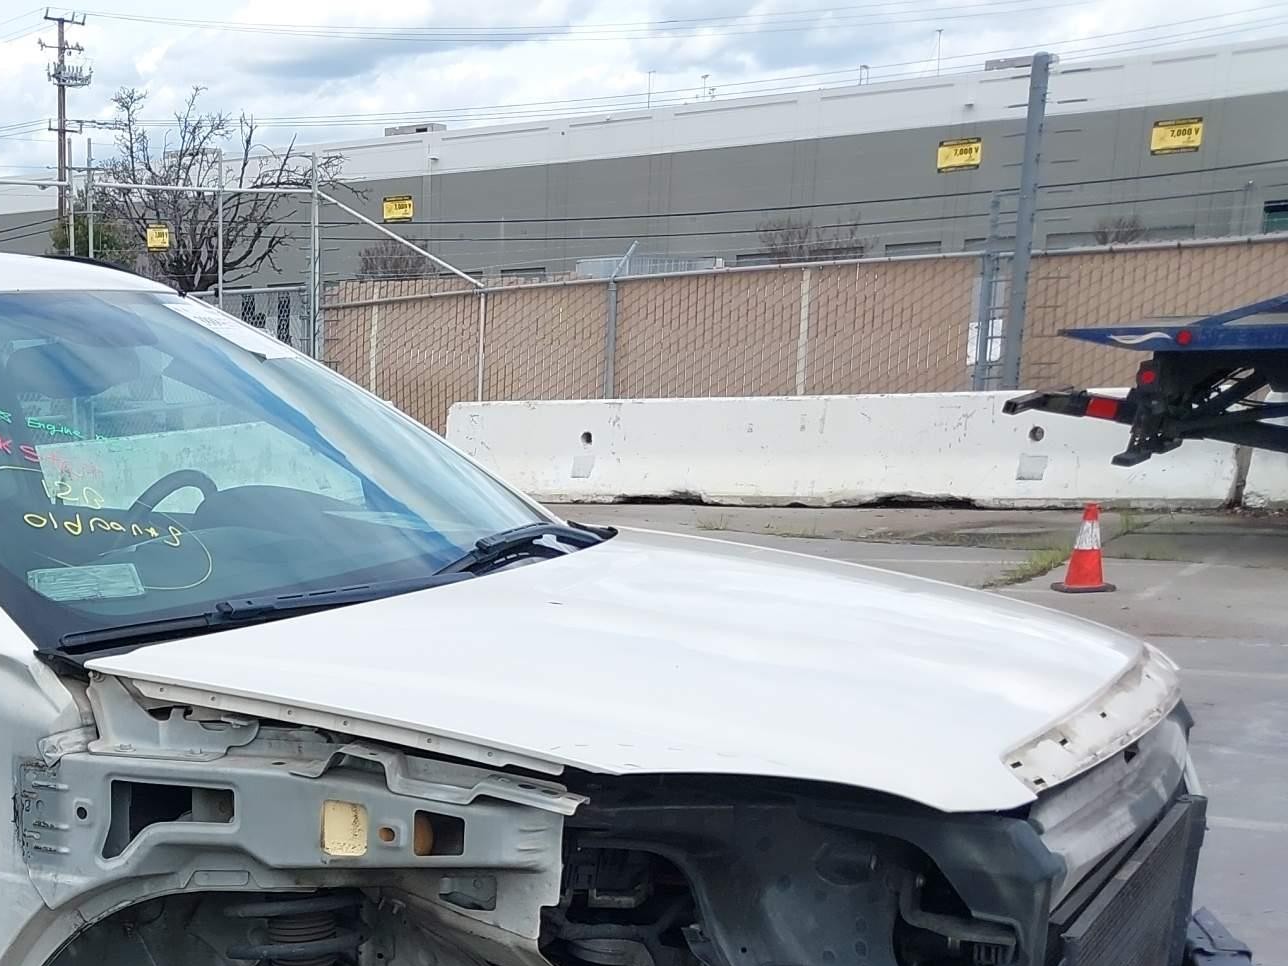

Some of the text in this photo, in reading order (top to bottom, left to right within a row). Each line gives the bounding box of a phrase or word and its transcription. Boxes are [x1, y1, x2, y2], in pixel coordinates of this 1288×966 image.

[1169, 127, 1200, 138] 7,000 V
[953, 147, 973, 157] 7,000
